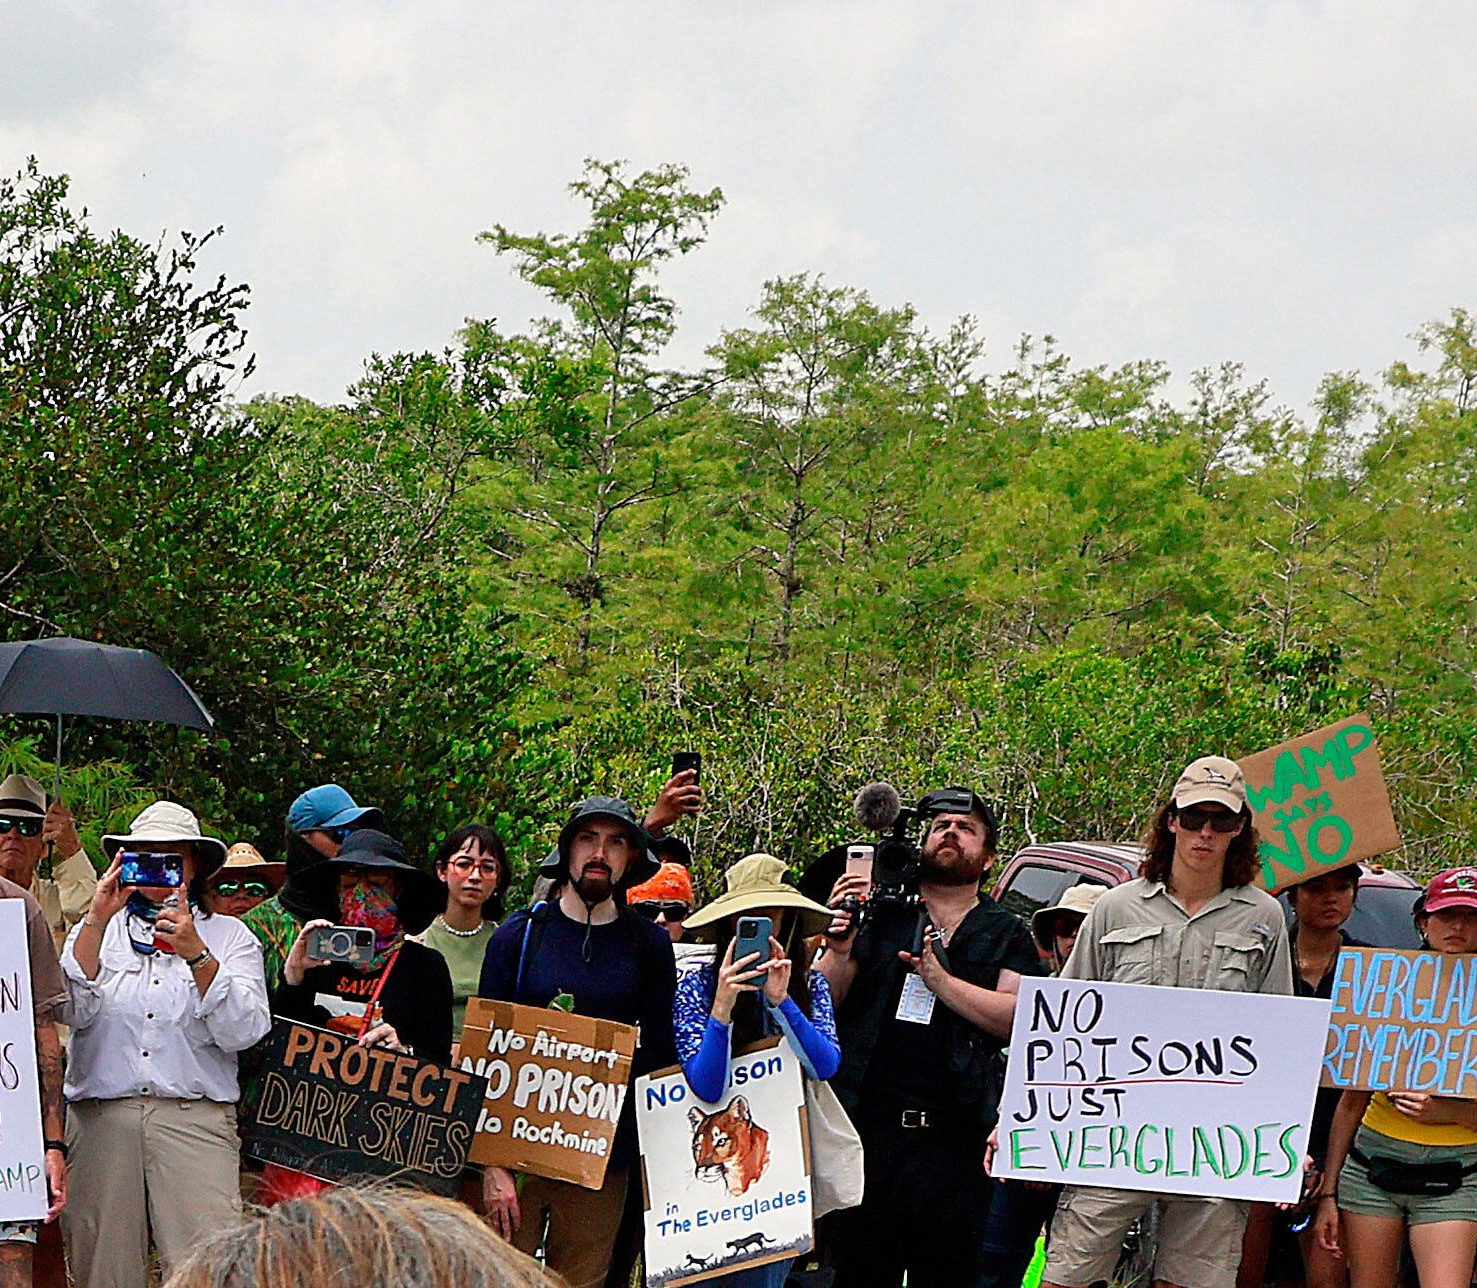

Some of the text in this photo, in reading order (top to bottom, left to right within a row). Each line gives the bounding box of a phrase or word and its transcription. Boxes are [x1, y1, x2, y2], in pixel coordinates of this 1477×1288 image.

[1245, 724, 1375, 813] WAMP
[1256, 814, 1354, 889] NO
[1029, 988, 1104, 1034] NO
[283, 1024, 472, 1114] PROTECT
[487, 1028, 620, 1070] No Airport
[1025, 1035, 1258, 1083] PRISONS
[513, 1062, 628, 1127] PRISON
[645, 1055, 783, 1112] No son
[1012, 1087, 1127, 1123] JUST
[256, 1071, 360, 1148] DARK
[357, 1101, 471, 1178] SKIES
[511, 1116, 608, 1157] Rockmine
[1008, 1122, 1305, 1180] EVERGLADES
[656, 1189, 807, 1237] The Everglades
[665, 1202, 679, 1217] in
